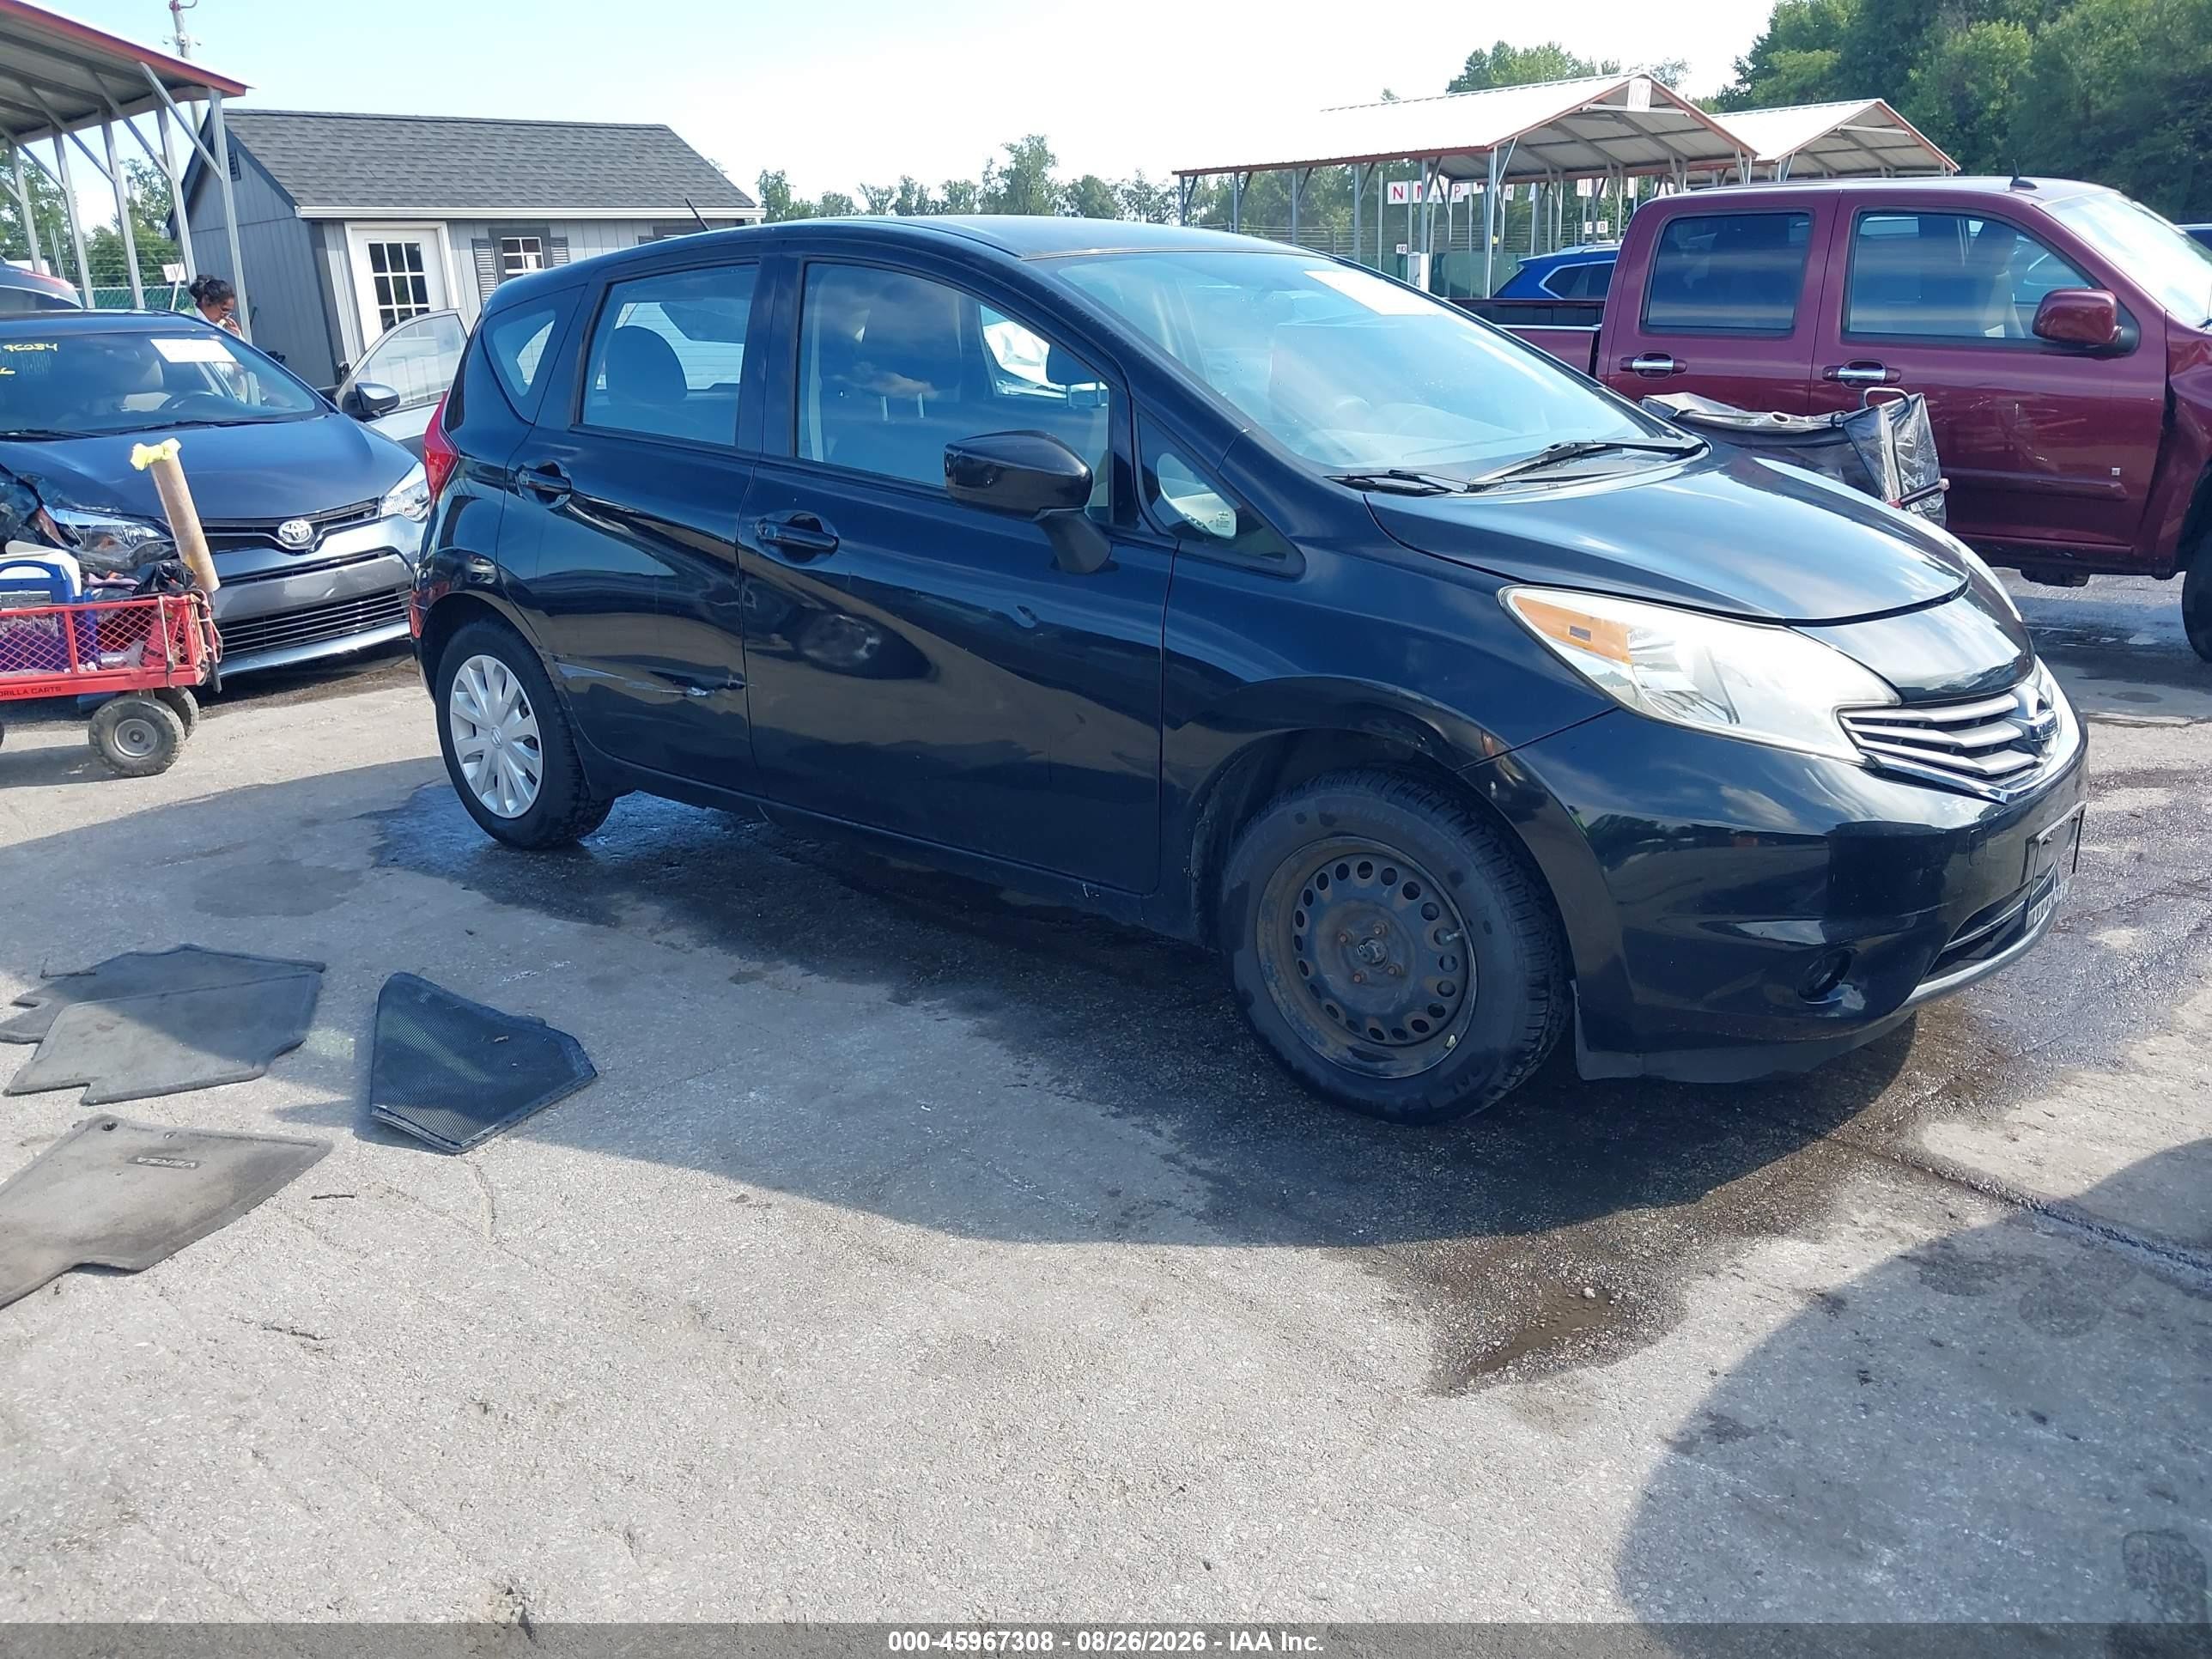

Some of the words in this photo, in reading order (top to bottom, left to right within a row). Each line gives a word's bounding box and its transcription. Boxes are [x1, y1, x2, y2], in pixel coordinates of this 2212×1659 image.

[1393, 185, 1404, 200] N
[1454, 185, 1461, 198] P
[1600, 222, 1606, 231] B
